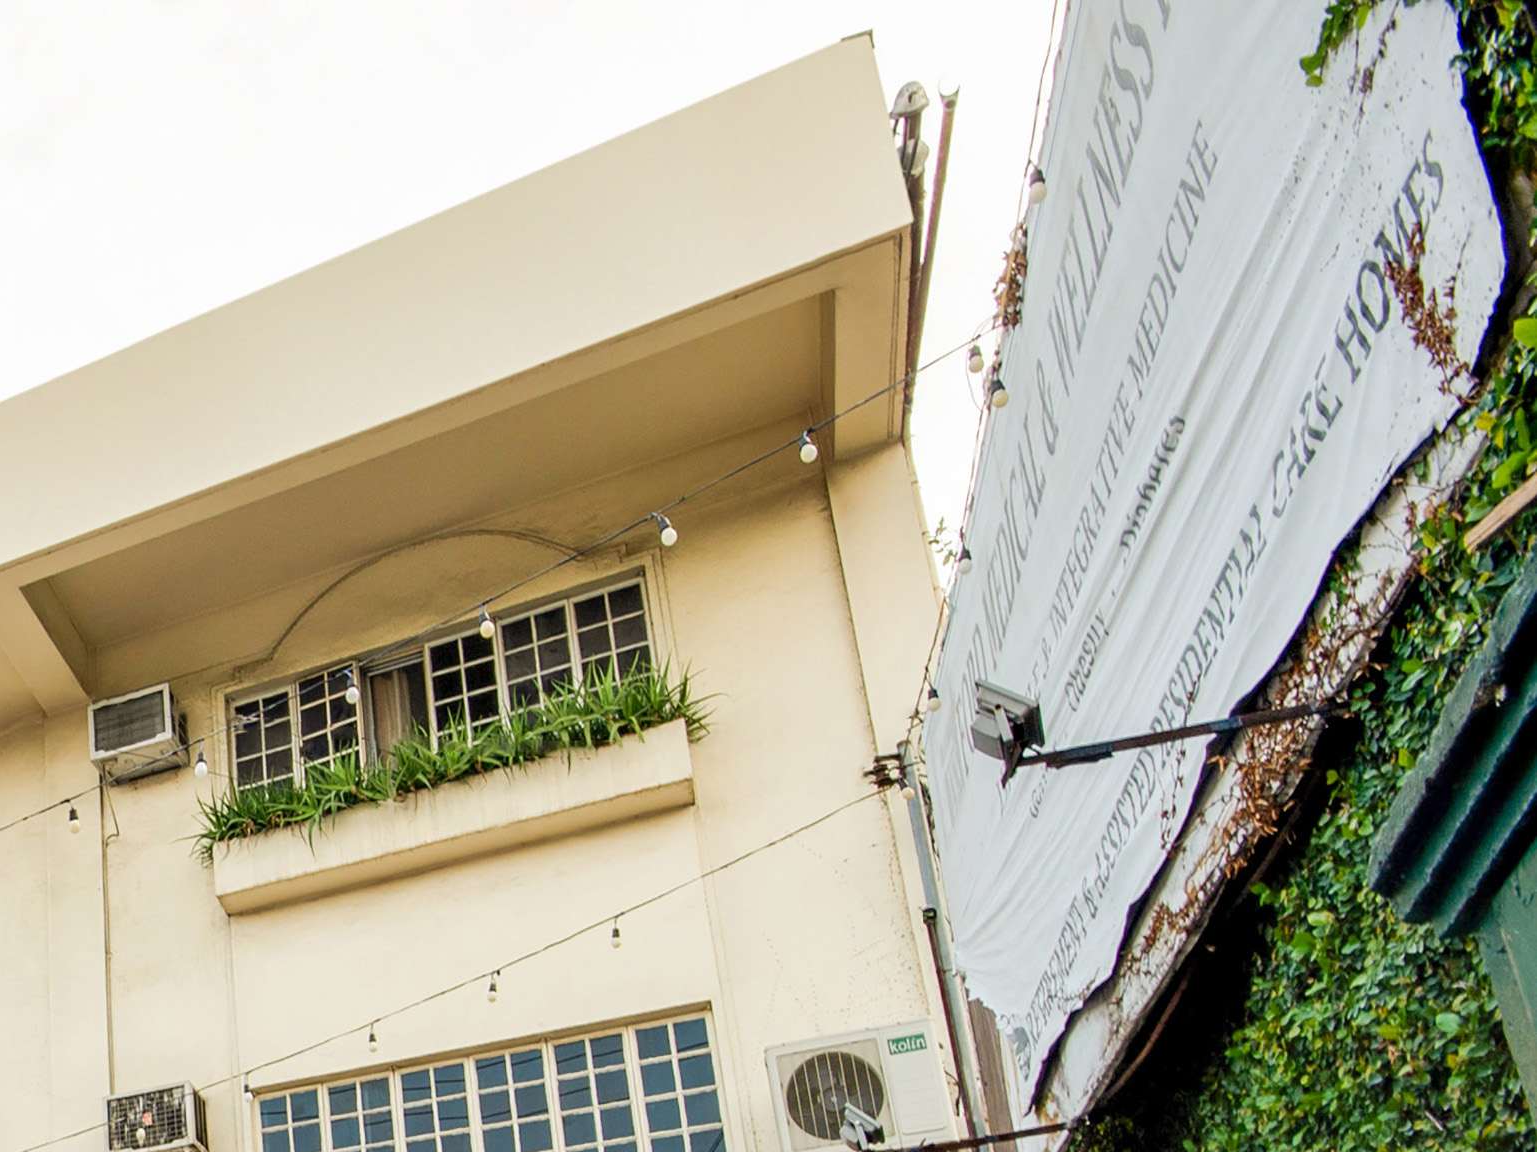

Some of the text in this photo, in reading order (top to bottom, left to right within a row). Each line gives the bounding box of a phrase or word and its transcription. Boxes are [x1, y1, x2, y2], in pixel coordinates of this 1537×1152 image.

[1047, 0, 1154, 398] WELLNESS
[1036, 358, 1060, 457] &
[1050, 382, 1136, 641] INTEGRATIVE
[1127, 118, 1218, 401] MEDICINE
[1272, 353, 1344, 518] CARE
[982, 411, 1047, 672] MEDICAL
[888, 1037, 926, 1054] kolin
